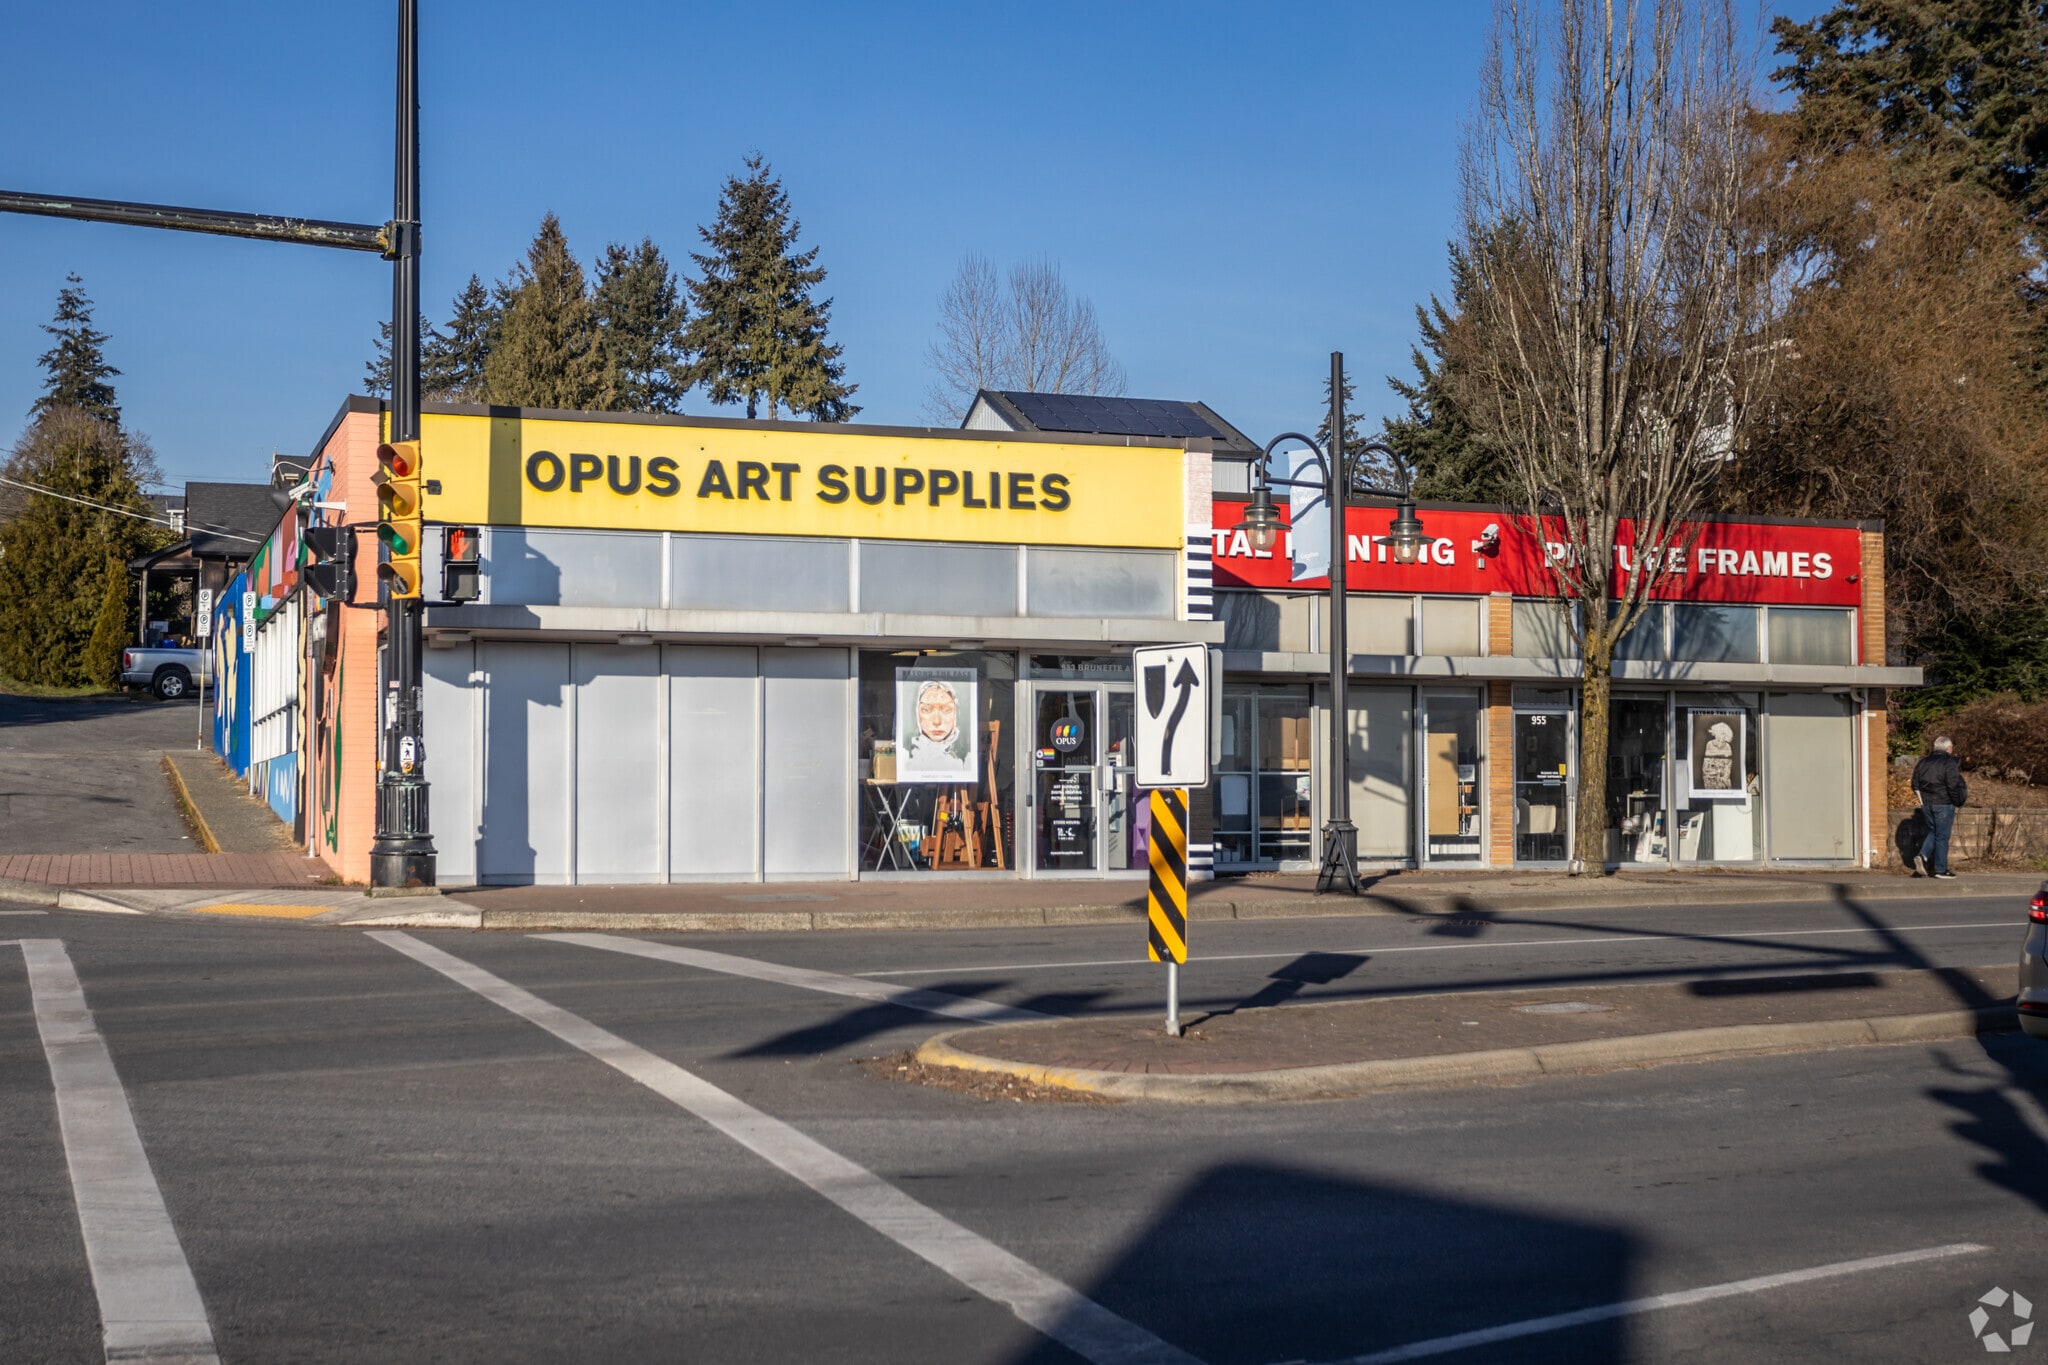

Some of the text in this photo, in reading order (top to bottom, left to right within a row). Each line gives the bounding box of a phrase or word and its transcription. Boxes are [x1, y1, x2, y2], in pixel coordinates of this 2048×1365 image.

[525, 449, 1071, 512] OPUS ART SUPPLIES
[1698, 548, 1833, 579] FRAMES
[1061, 664, 1075, 672] 953
[1077, 664, 1123, 672] BRUNETTE
[1531, 715, 1547, 725] 955
[1055, 737, 1077, 745] OPUS
